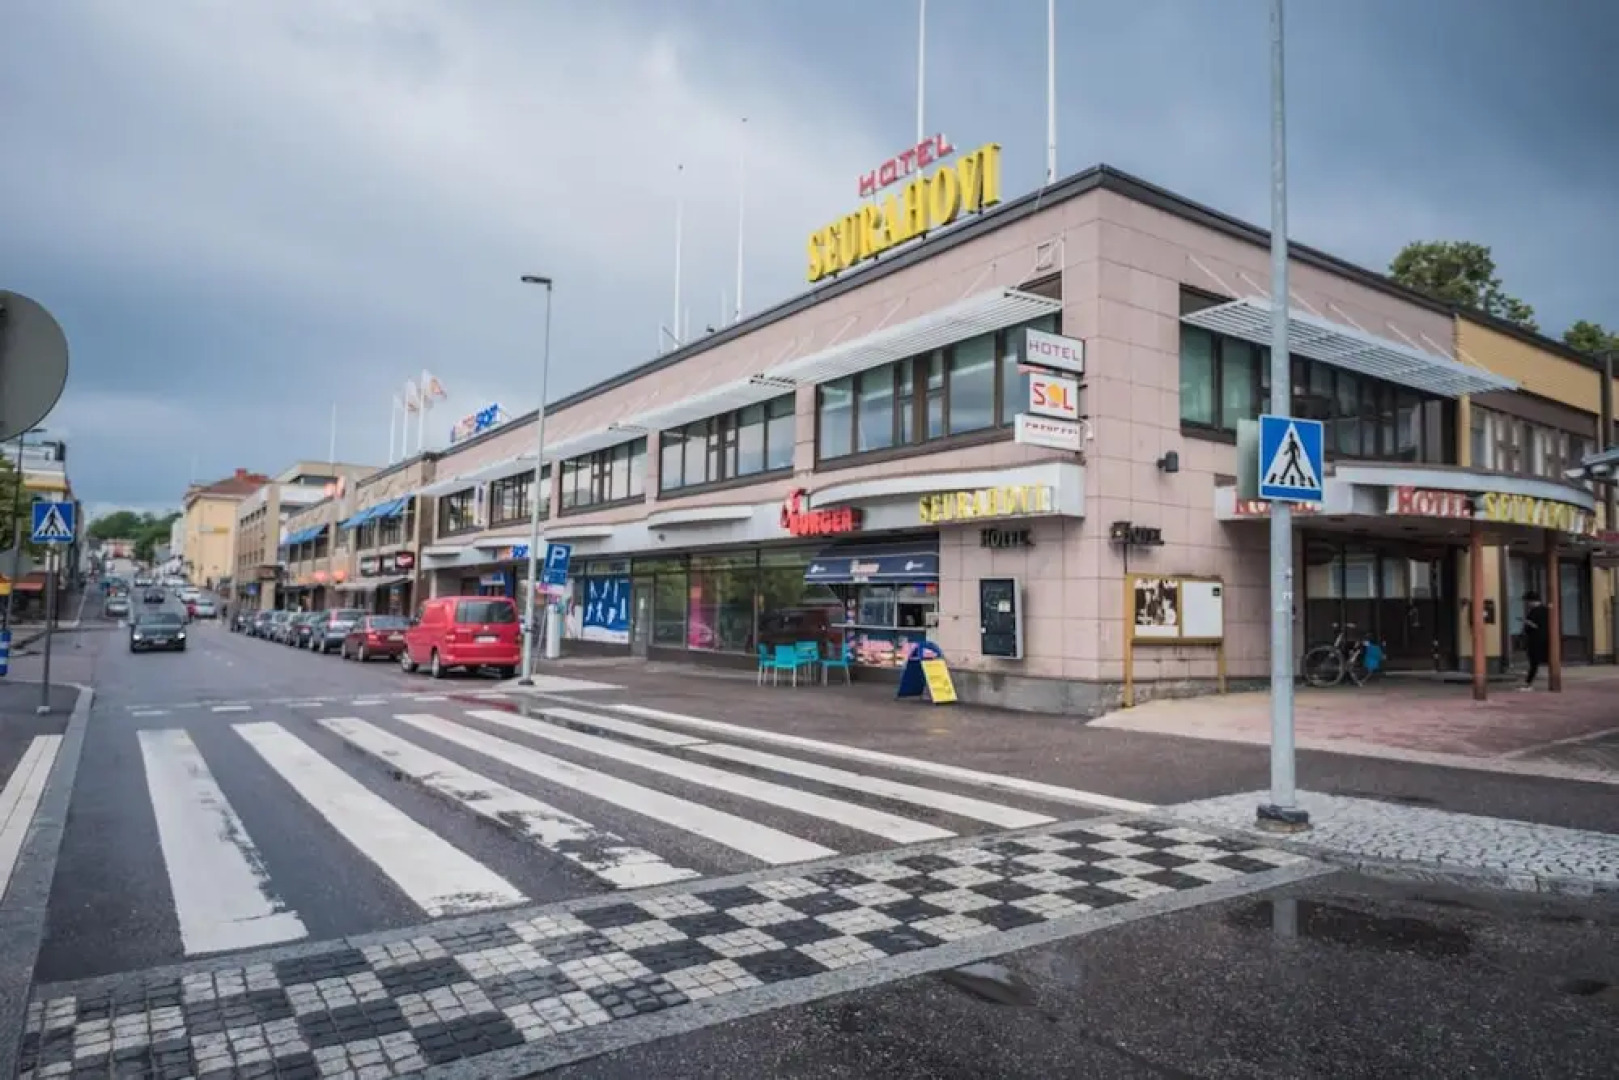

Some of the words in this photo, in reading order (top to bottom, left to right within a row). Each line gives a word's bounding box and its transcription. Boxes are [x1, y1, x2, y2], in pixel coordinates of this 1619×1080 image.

[858, 133, 955, 197] HOTEL
[807, 142, 1001, 282] SEURAHOVI
[1028, 339, 1081, 361] HOTEL
[919, 482, 1047, 523] SEURAHOVI
